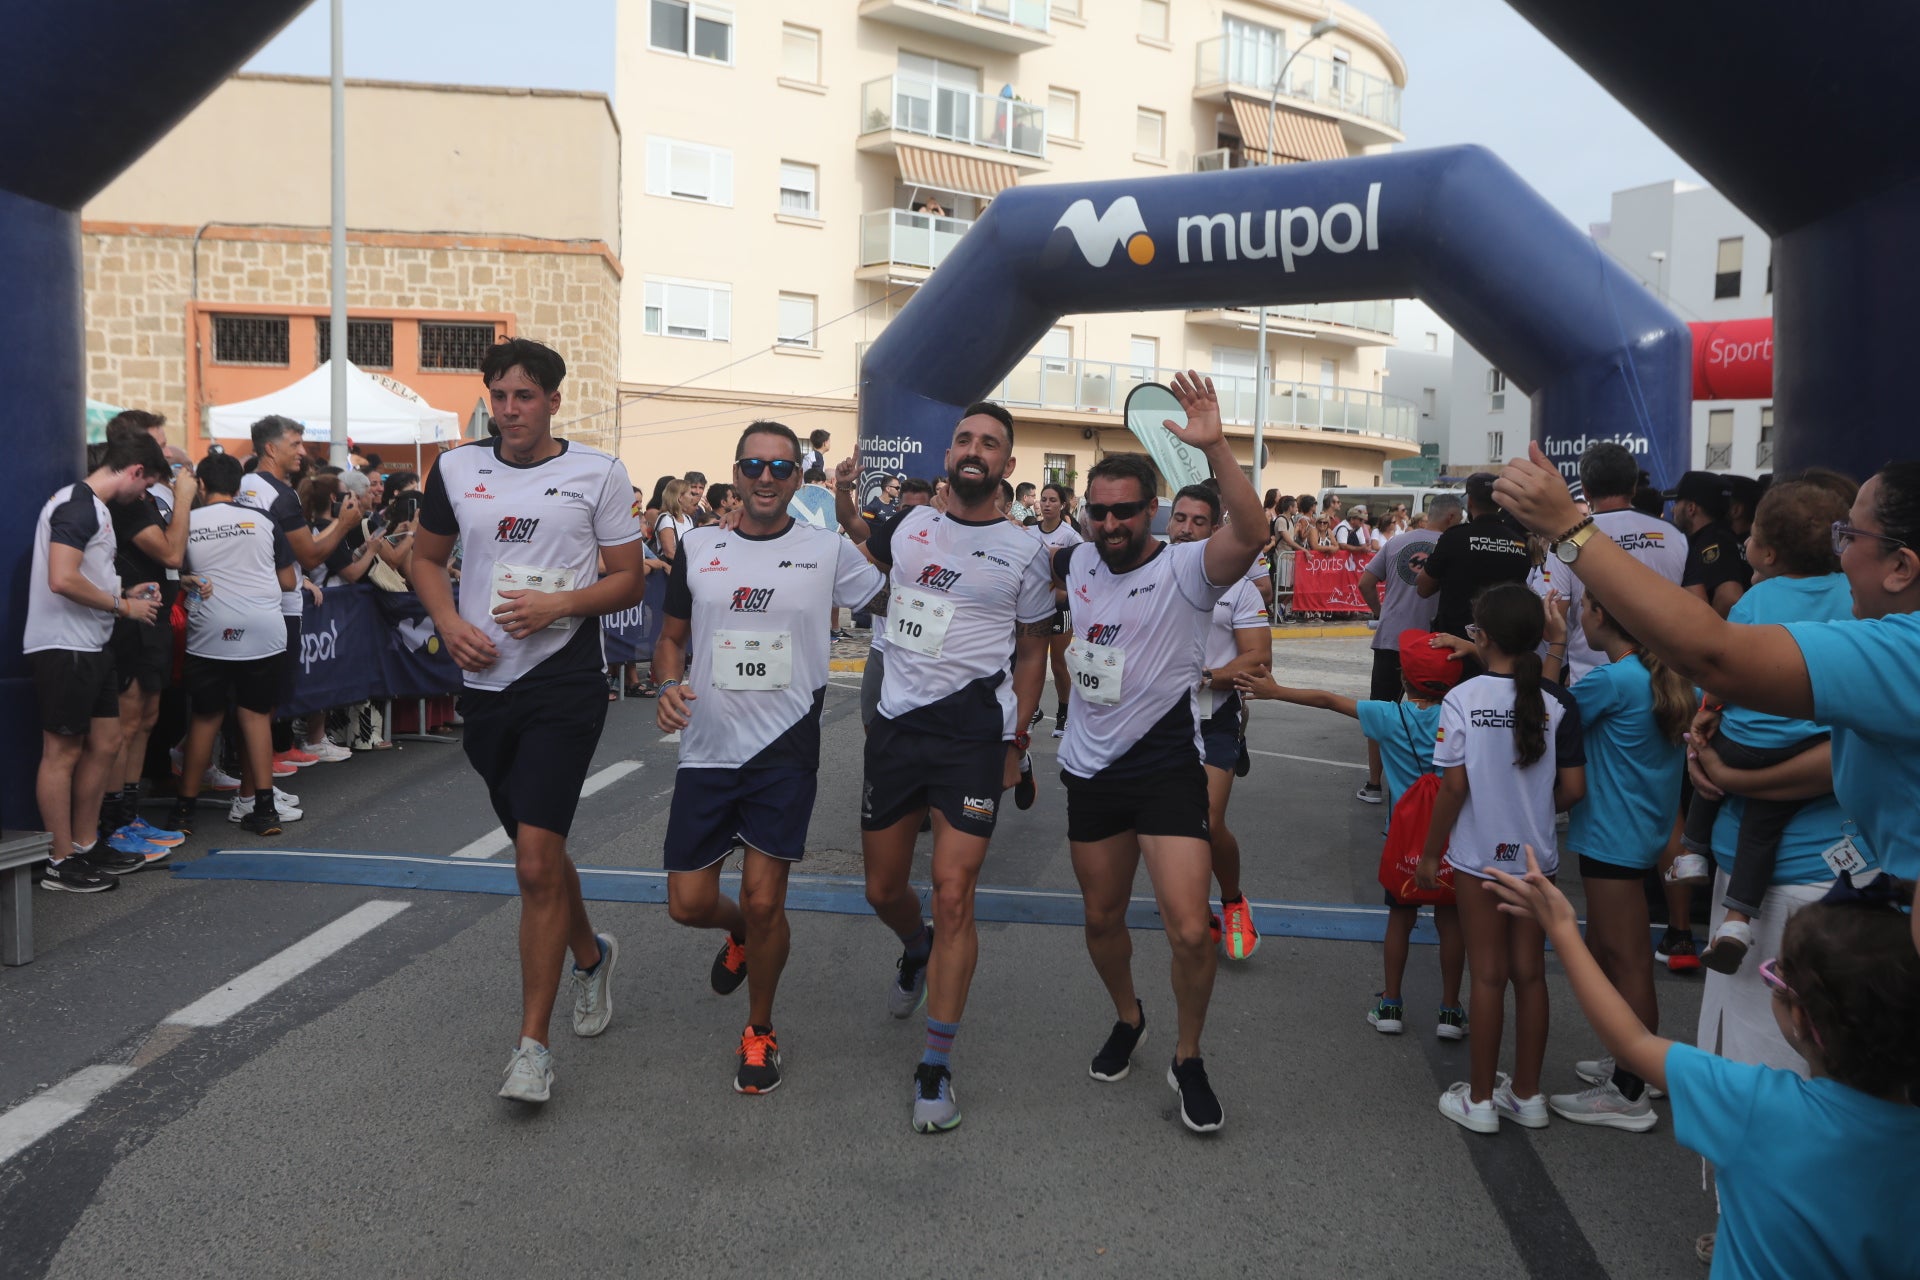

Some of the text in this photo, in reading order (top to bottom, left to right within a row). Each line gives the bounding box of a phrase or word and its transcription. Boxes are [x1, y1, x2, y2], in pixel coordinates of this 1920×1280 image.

[1177, 182, 1382, 273] mupol
[862, 453, 904, 472] mupol
[561, 490, 585, 500] mupol
[189, 529, 256, 544] NACIONAL
[1469, 536, 1516, 547] POLICIA
[1610, 533, 1647, 543] LICIA
[1470, 543, 1527, 557] NACIONAL
[795, 562, 818, 570] mupol
[898, 618, 923, 638] 110
[735, 662, 767, 677] 108
[1076, 671, 1100, 690] 109
[1470, 709, 1519, 719] POLIC
